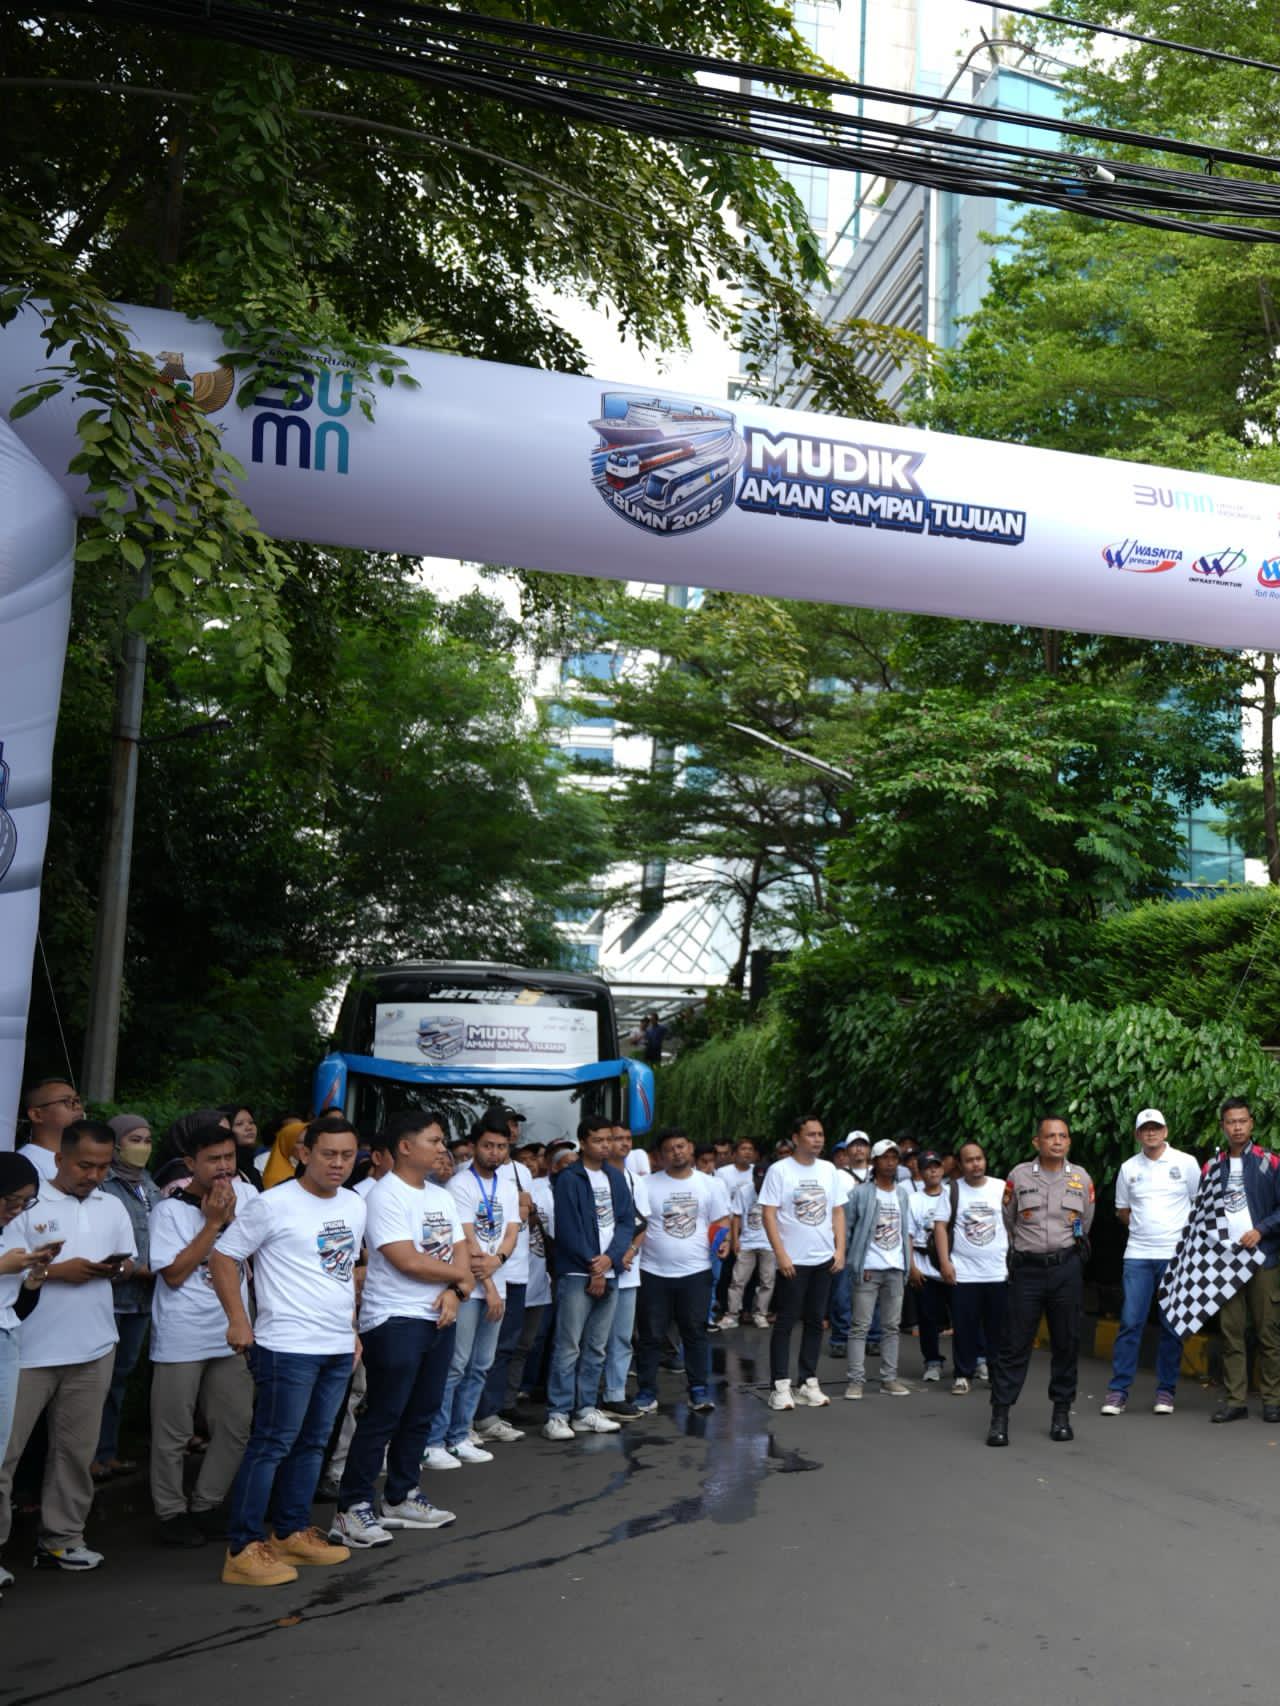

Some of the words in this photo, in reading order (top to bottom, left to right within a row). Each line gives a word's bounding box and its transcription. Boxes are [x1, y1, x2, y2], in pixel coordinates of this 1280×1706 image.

[751, 432, 913, 490] MUDIK
[613, 491, 668, 530] BUMN
[671, 494, 723, 530] 2025
[741, 477, 824, 510] AMAN
[830, 489, 924, 524] SAMPAI
[931, 502, 1023, 536] TUJUAN
[1135, 545, 1183, 561] WASKITA
[1128, 556, 1160, 568] precast
[1188, 576, 1243, 588] INFRASTRUKTUR
[469, 1026, 525, 1041] MUDIK
